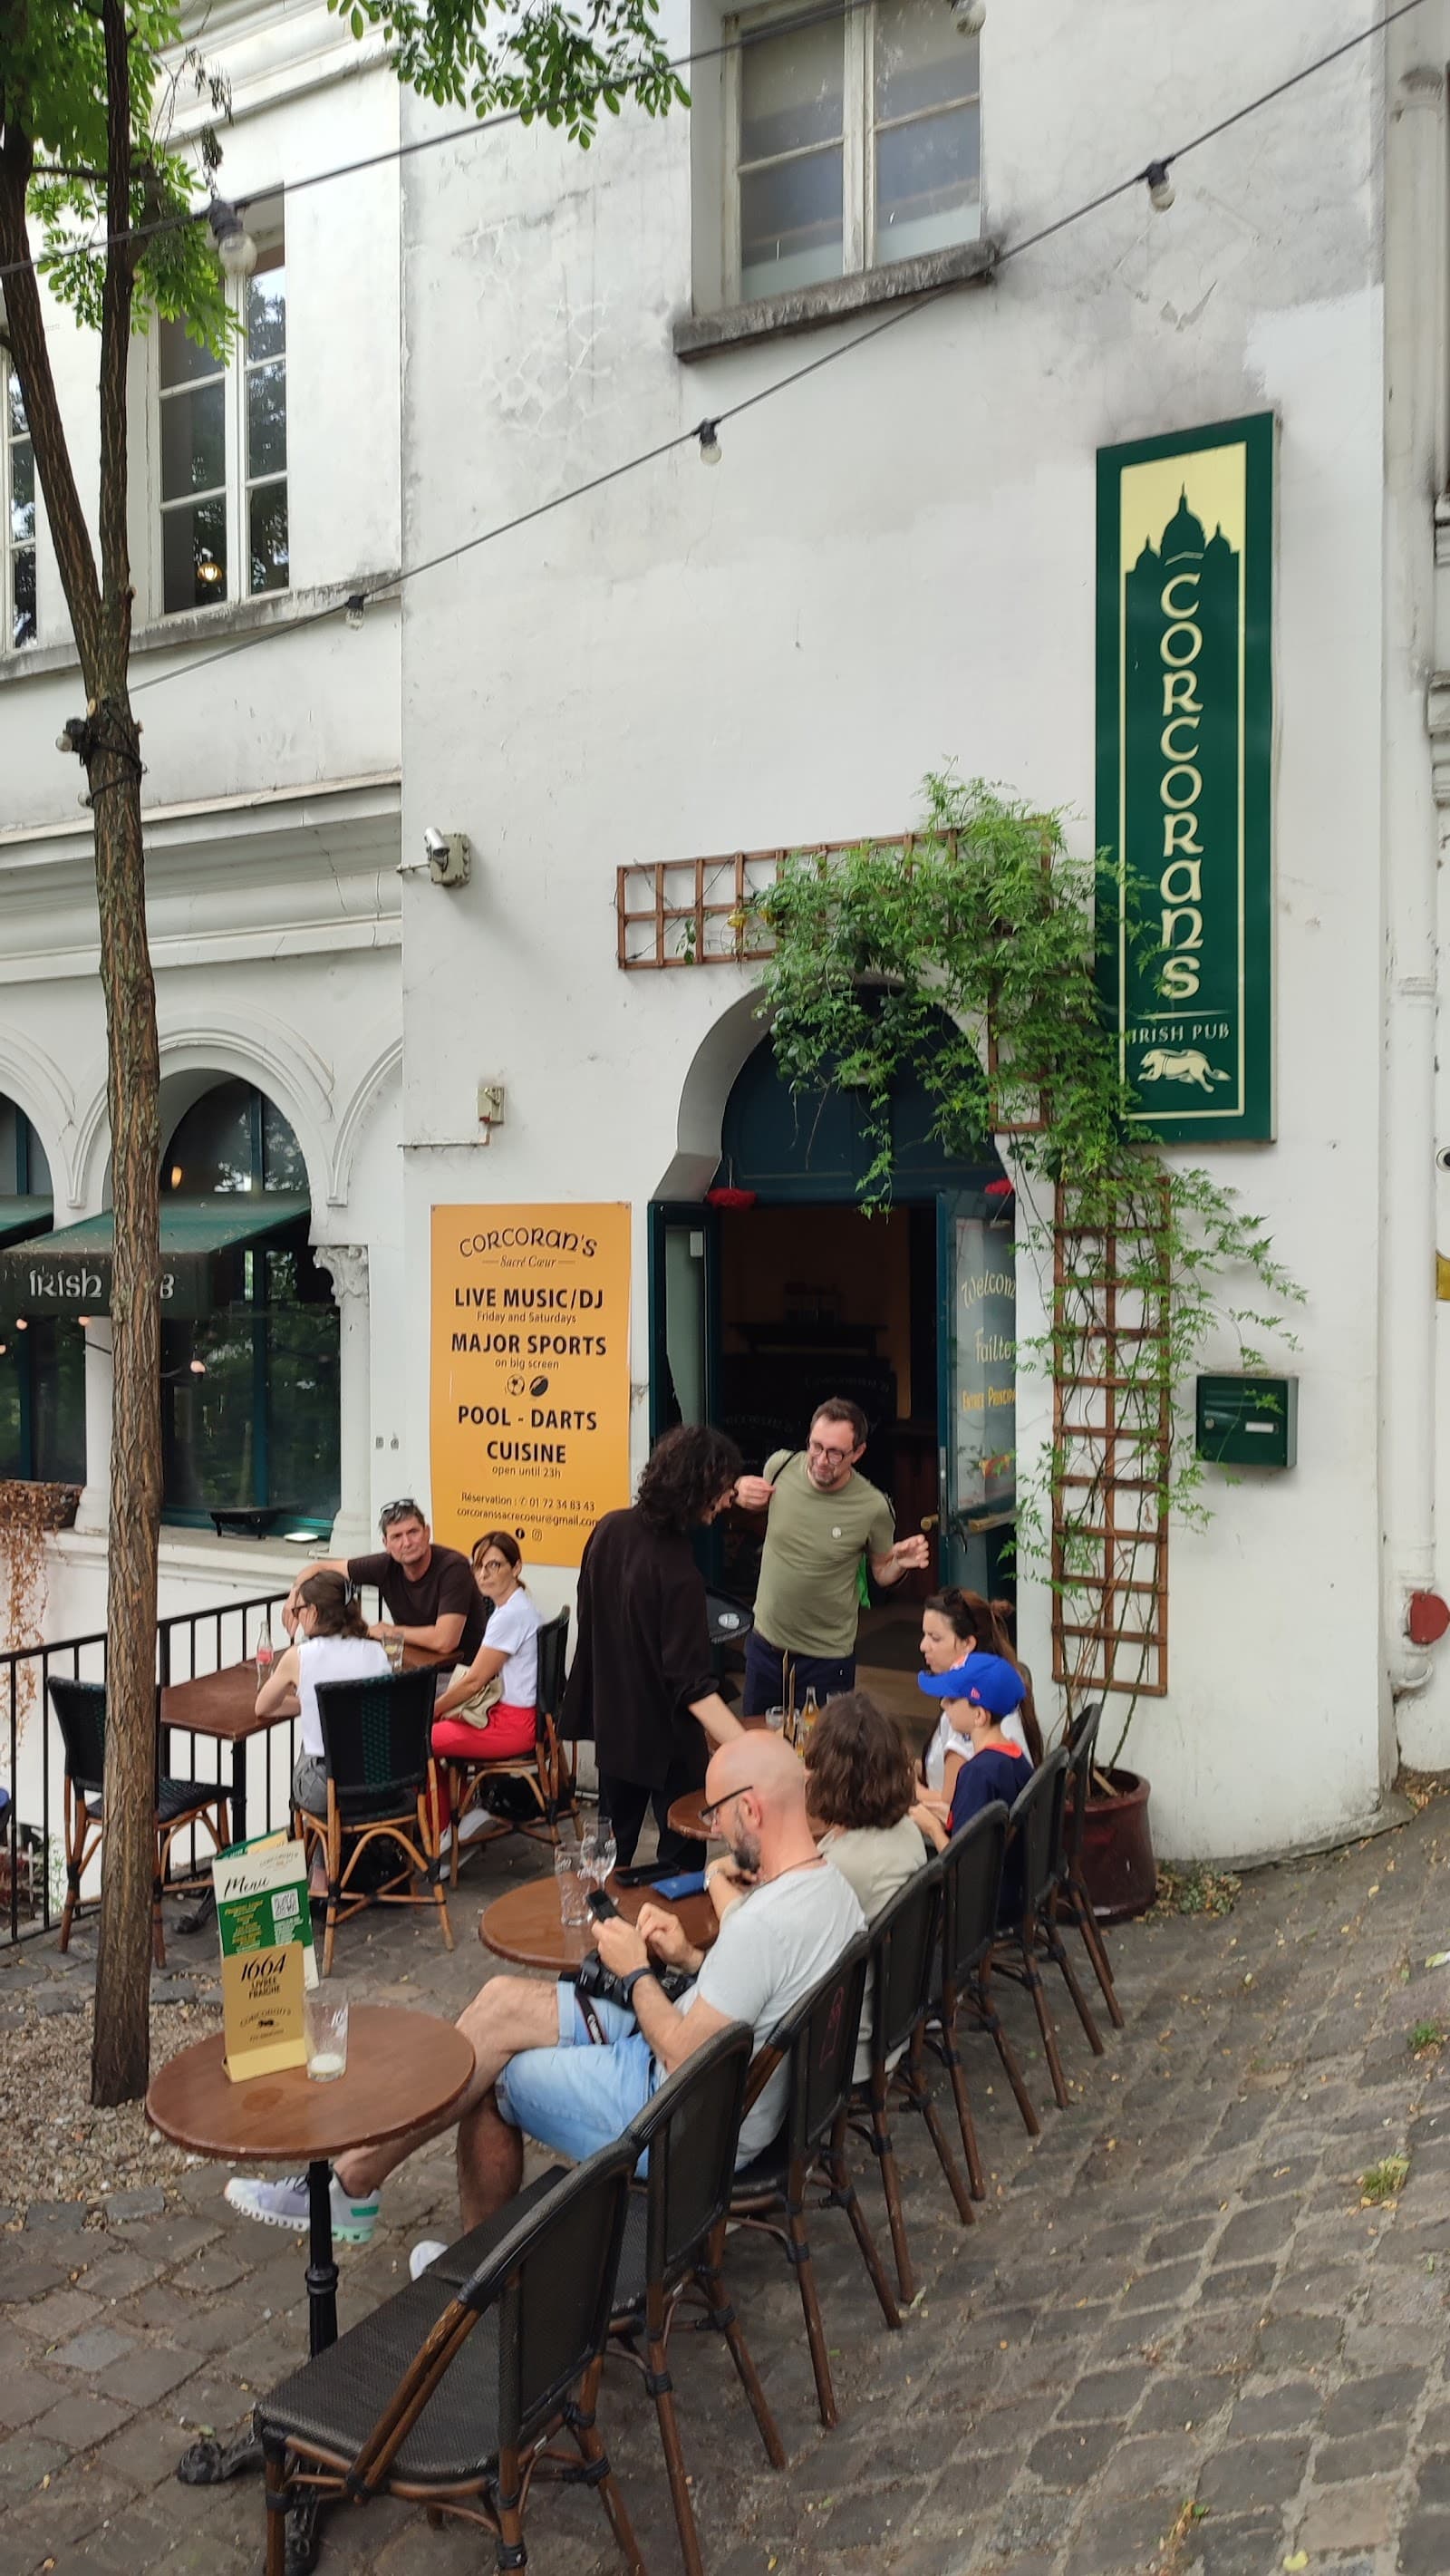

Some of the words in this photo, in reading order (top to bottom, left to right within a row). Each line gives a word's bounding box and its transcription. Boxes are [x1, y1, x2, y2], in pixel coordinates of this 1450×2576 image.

[1131, 1025, 1184, 1044] IRISH
[1193, 1022, 1230, 1041] PUB
[455, 1288, 497, 1307] LIVE
[503, 1288, 604, 1310] MUSIC/DJ
[962, 1269, 1015, 1310] Welcom
[477, 1312, 506, 1324] Friday
[508, 1312, 526, 1322] and
[528, 1312, 576, 1325] Saturdays
[451, 1333, 520, 1353] MAJOR
[527, 1335, 607, 1356] SPORTS
[495, 1359, 508, 1369] on
[510, 1357, 526, 1370] big
[527, 1360, 559, 1370] screen
[459, 1406, 511, 1426] POOL
[531, 1409, 597, 1430] DARTS
[487, 1441, 566, 1464] CUISINE
[492, 1466, 516, 1477] open
[518, 1466, 540, 1477] until
[543, 1467, 561, 1479] 23h
[529, 1497, 539, 1508] 01
[224, 1875, 269, 1899] Menu
[241, 1952, 286, 1981] 1664
